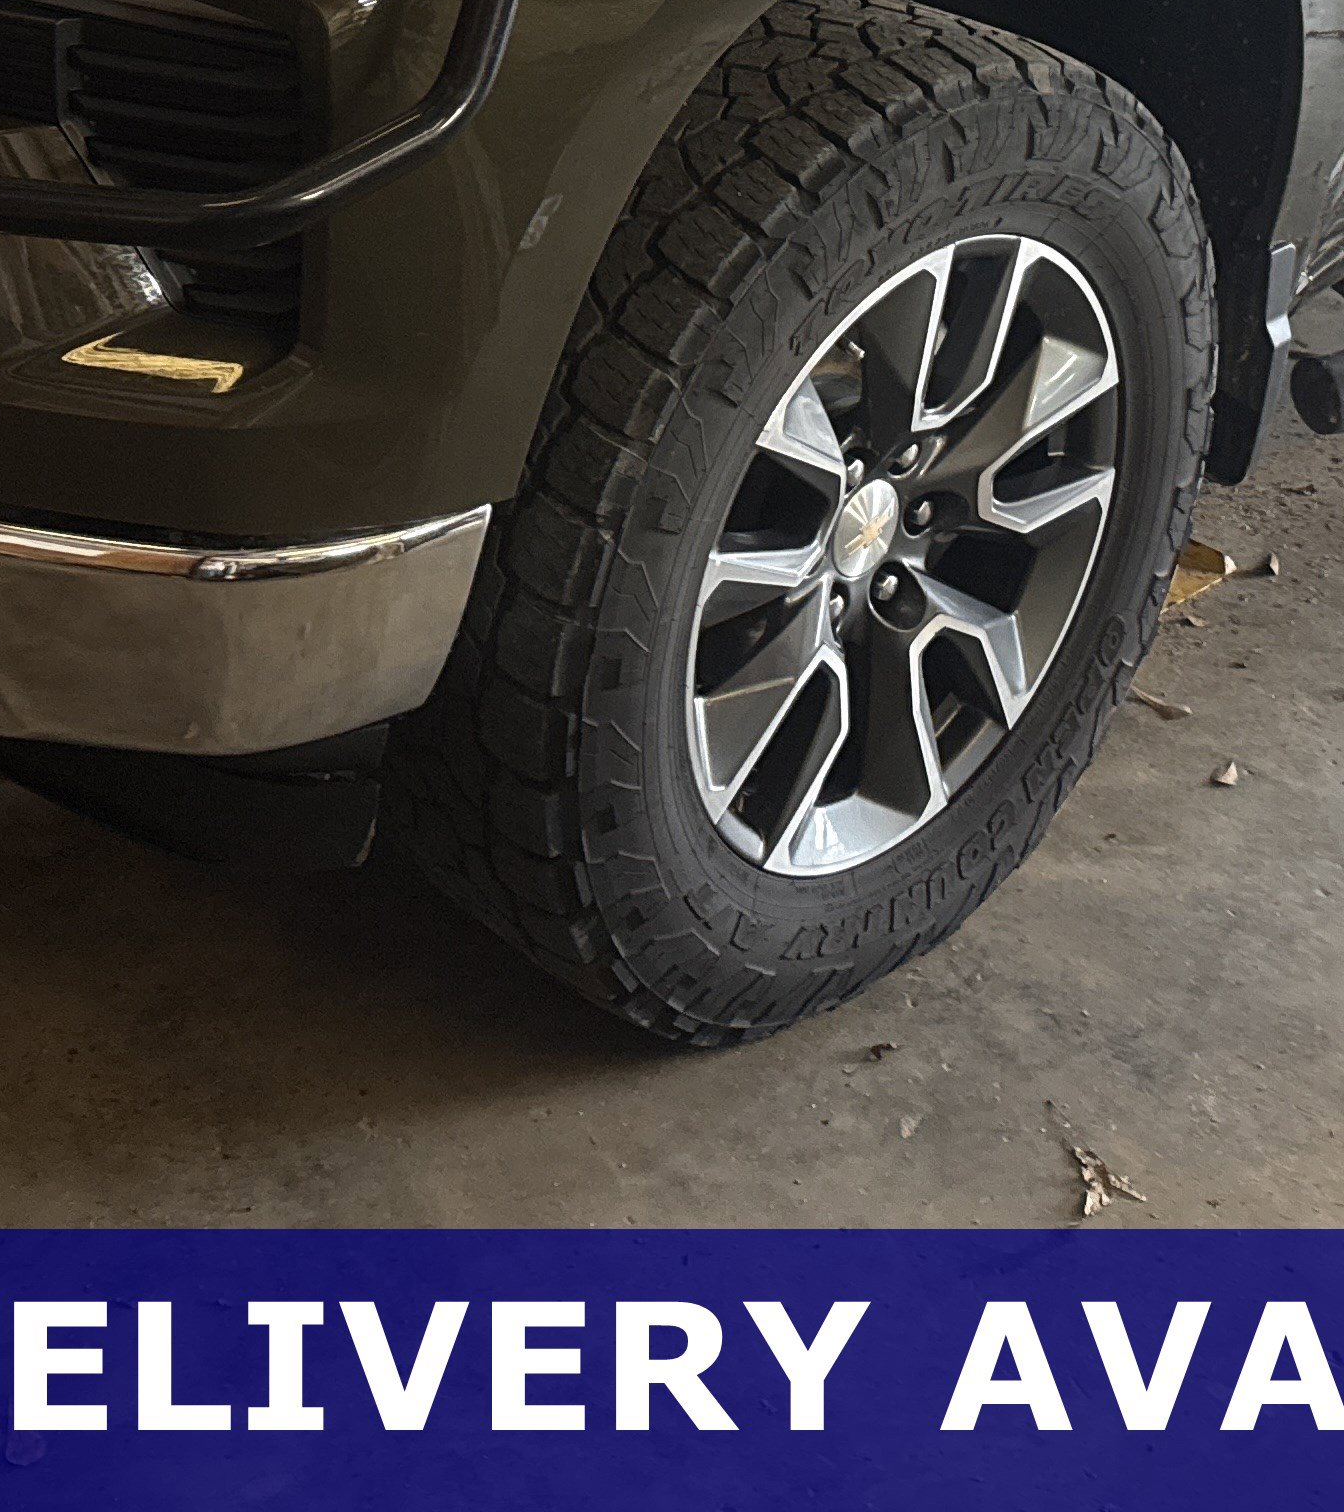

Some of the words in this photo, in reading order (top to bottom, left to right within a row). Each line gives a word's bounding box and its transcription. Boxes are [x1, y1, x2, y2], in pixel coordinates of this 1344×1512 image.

[950, 171, 1126, 225] TIRES
[1018, 613, 1127, 806] OPEN
[778, 797, 1015, 962] COUNTRY
